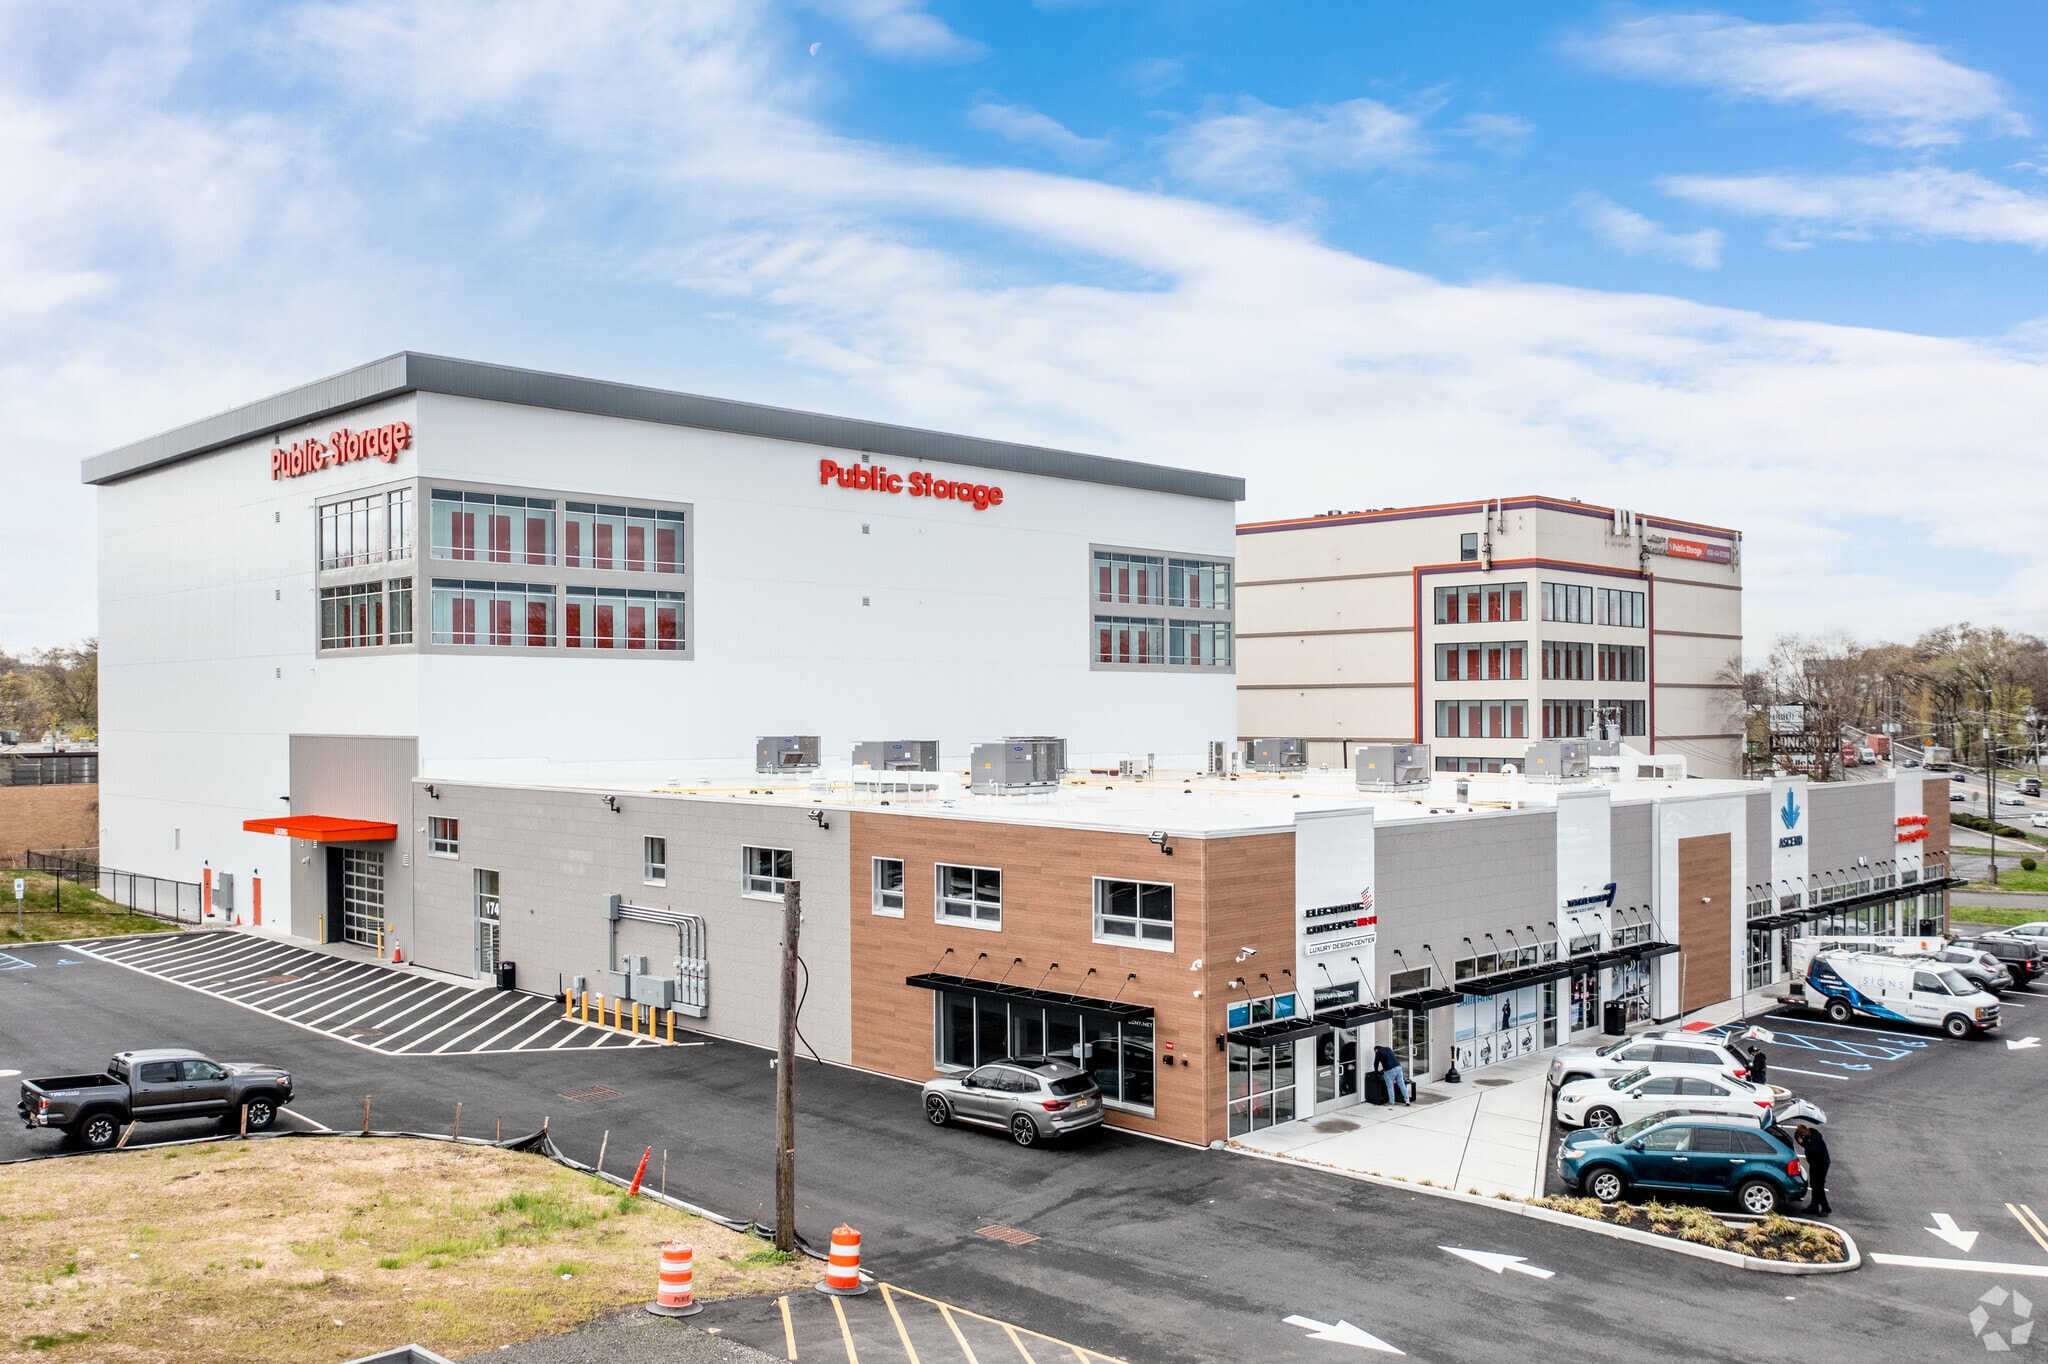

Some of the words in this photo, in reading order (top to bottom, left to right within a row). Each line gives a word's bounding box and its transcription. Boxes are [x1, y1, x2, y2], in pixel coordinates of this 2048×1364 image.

[271, 438, 327, 480] Public
[329, 421, 410, 465] Storage
[820, 459, 903, 494] Public
[909, 471, 1004, 511] Storage
[1672, 542, 1686, 553] Public
[1686, 545, 1703, 557] Storage
[1779, 835, 1803, 848] ASCEND
[486, 901, 500, 915] 174
[1305, 902, 1364, 918] ELECTRONIC
[1306, 919, 1358, 935] CONCEPTS
[1309, 945, 1331, 954] LUXURY
[1332, 940, 1354, 950] DESIGN
[1354, 936, 1376, 946] CENTER
[1863, 976, 1905, 990] SIGNS
